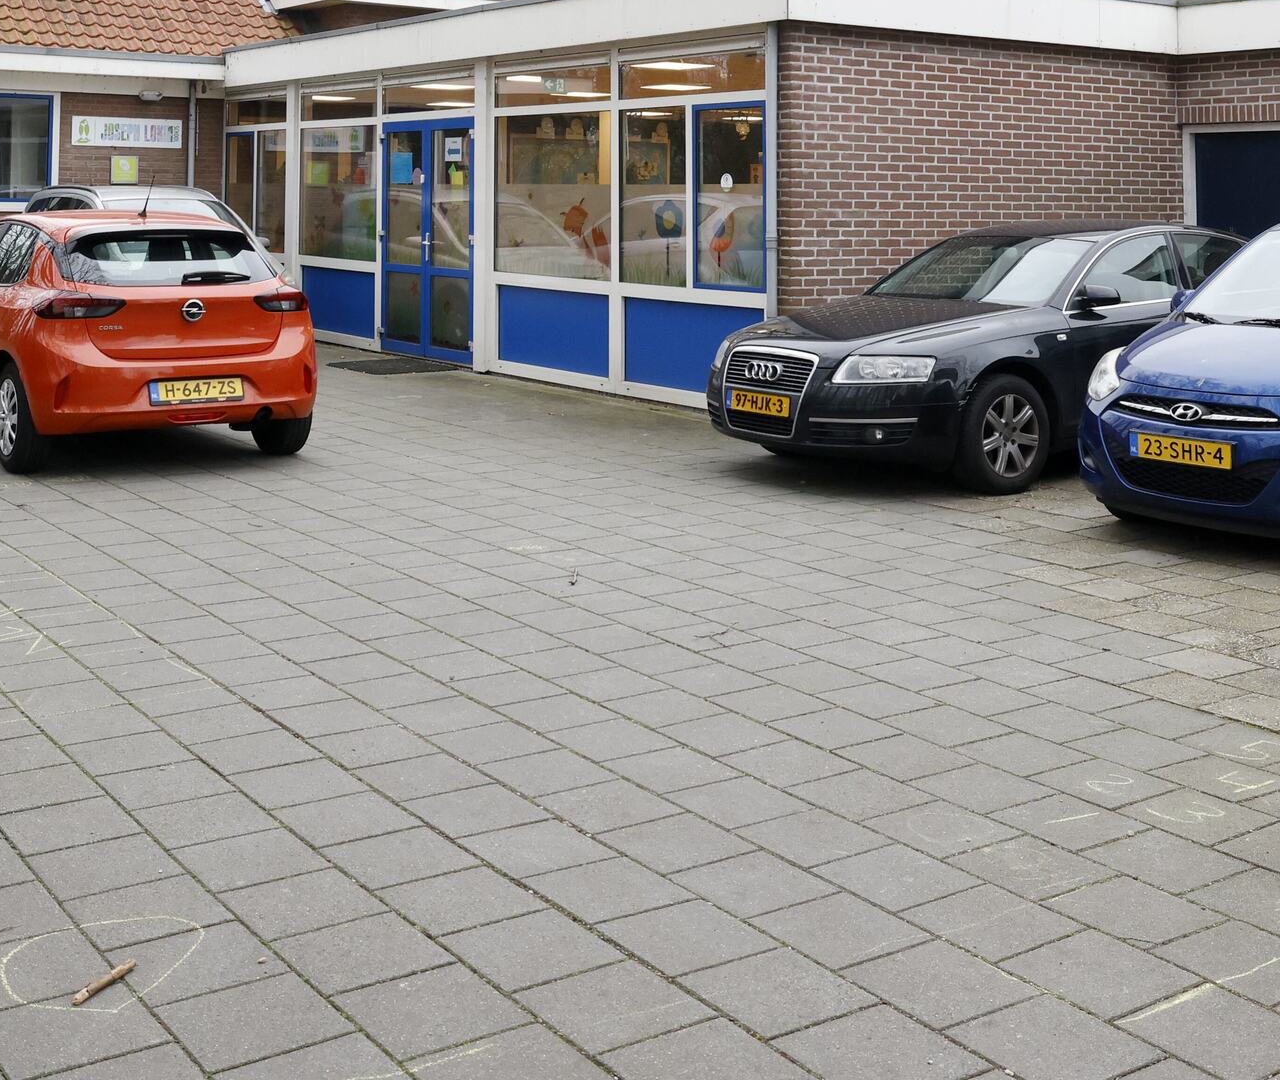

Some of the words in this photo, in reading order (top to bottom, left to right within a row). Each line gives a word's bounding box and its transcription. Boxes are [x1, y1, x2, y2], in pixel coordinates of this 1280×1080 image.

[165, 380, 237, 398] H-647-ZS
[735, 393, 784, 413] 97-HJK-3
[1143, 438, 1224, 465] 23-SHR-4
